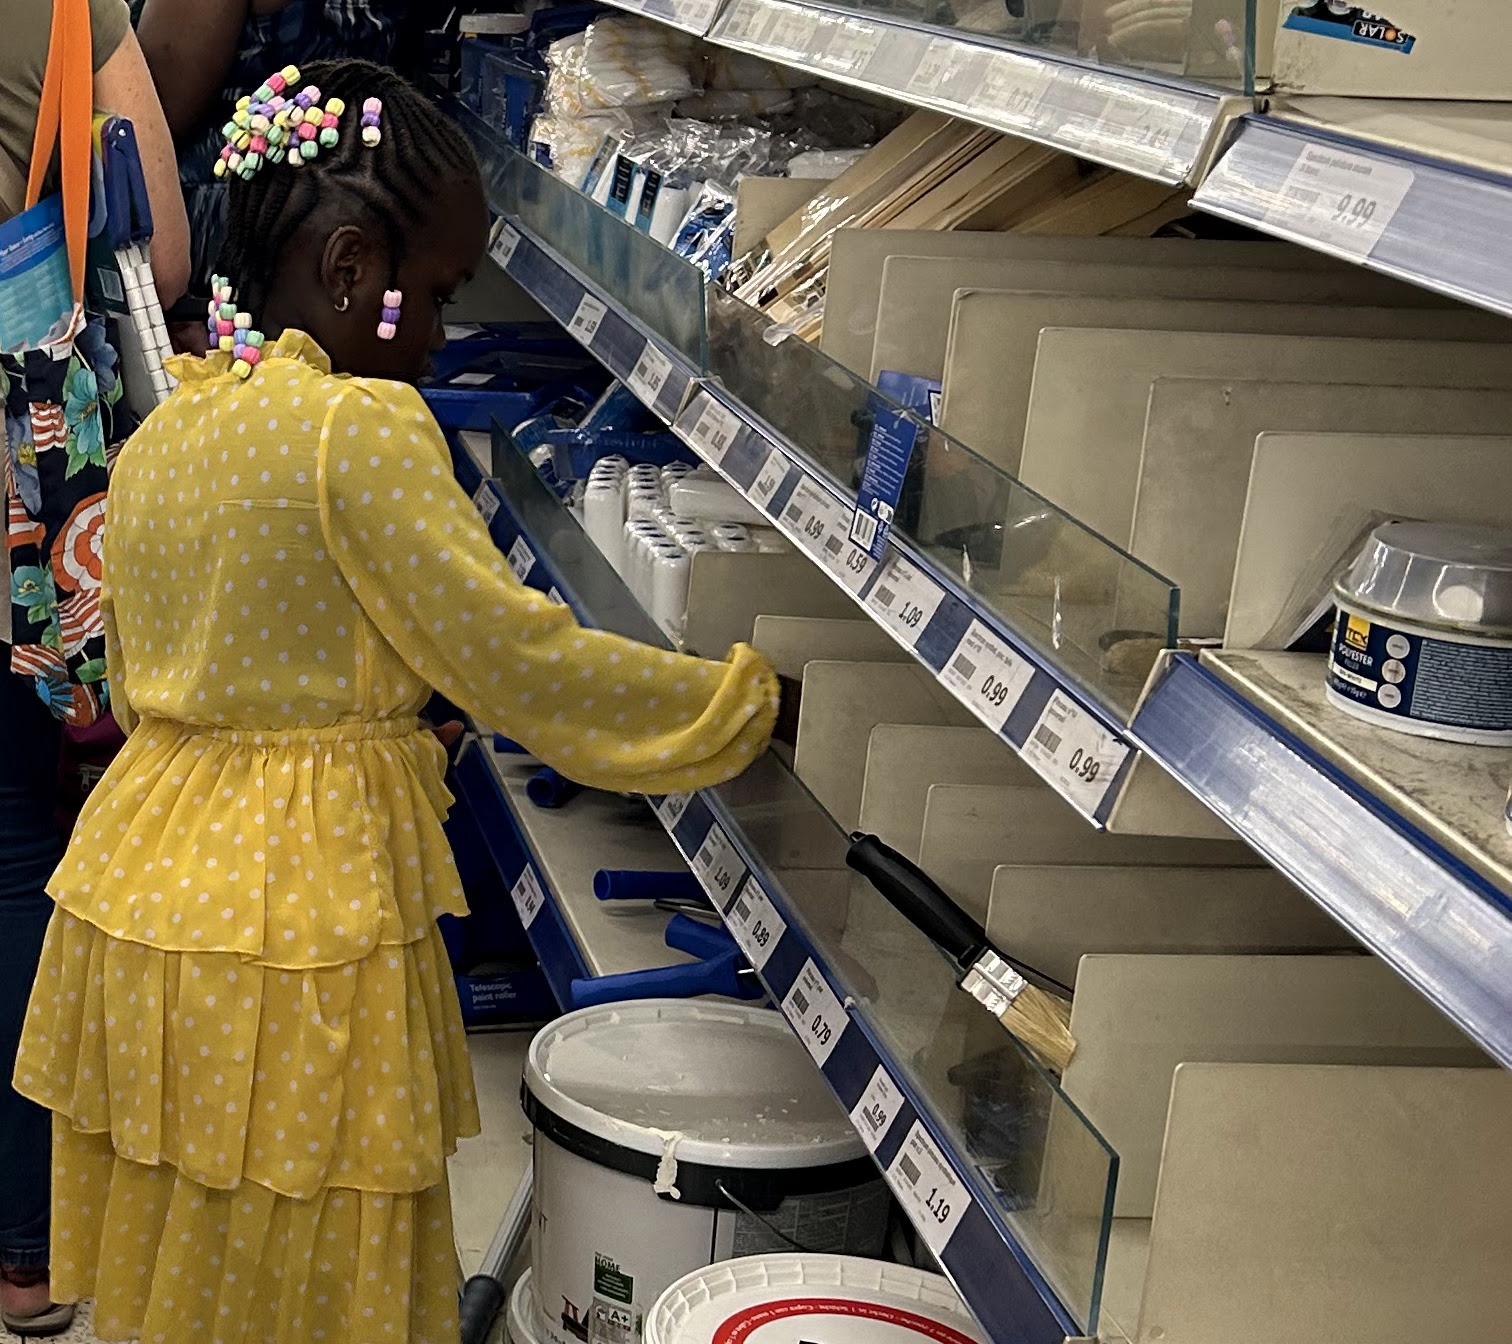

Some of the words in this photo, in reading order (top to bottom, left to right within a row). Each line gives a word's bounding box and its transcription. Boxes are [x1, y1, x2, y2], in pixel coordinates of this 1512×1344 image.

[1358, 22, 1405, 44] SOLAR
[1331, 194, 1377, 229] 9.99
[804, 515, 824, 540] 0.99
[846, 549, 868, 574] 0.59
[898, 601, 923, 628] 1.09
[1339, 643, 1373, 667] POLYESTER
[981, 674, 1008, 706] 0.99
[1069, 748, 1099, 782] 0.99
[470, 983, 512, 993] Telescopic
[472, 994, 494, 1004] paint
[495, 992, 516, 1000] roller
[811, 1014, 832, 1046] 0.79
[872, 1103, 887, 1127] 0.99
[925, 1188, 951, 1224] 1.19
[611, 1310, 629, 1324] A+
